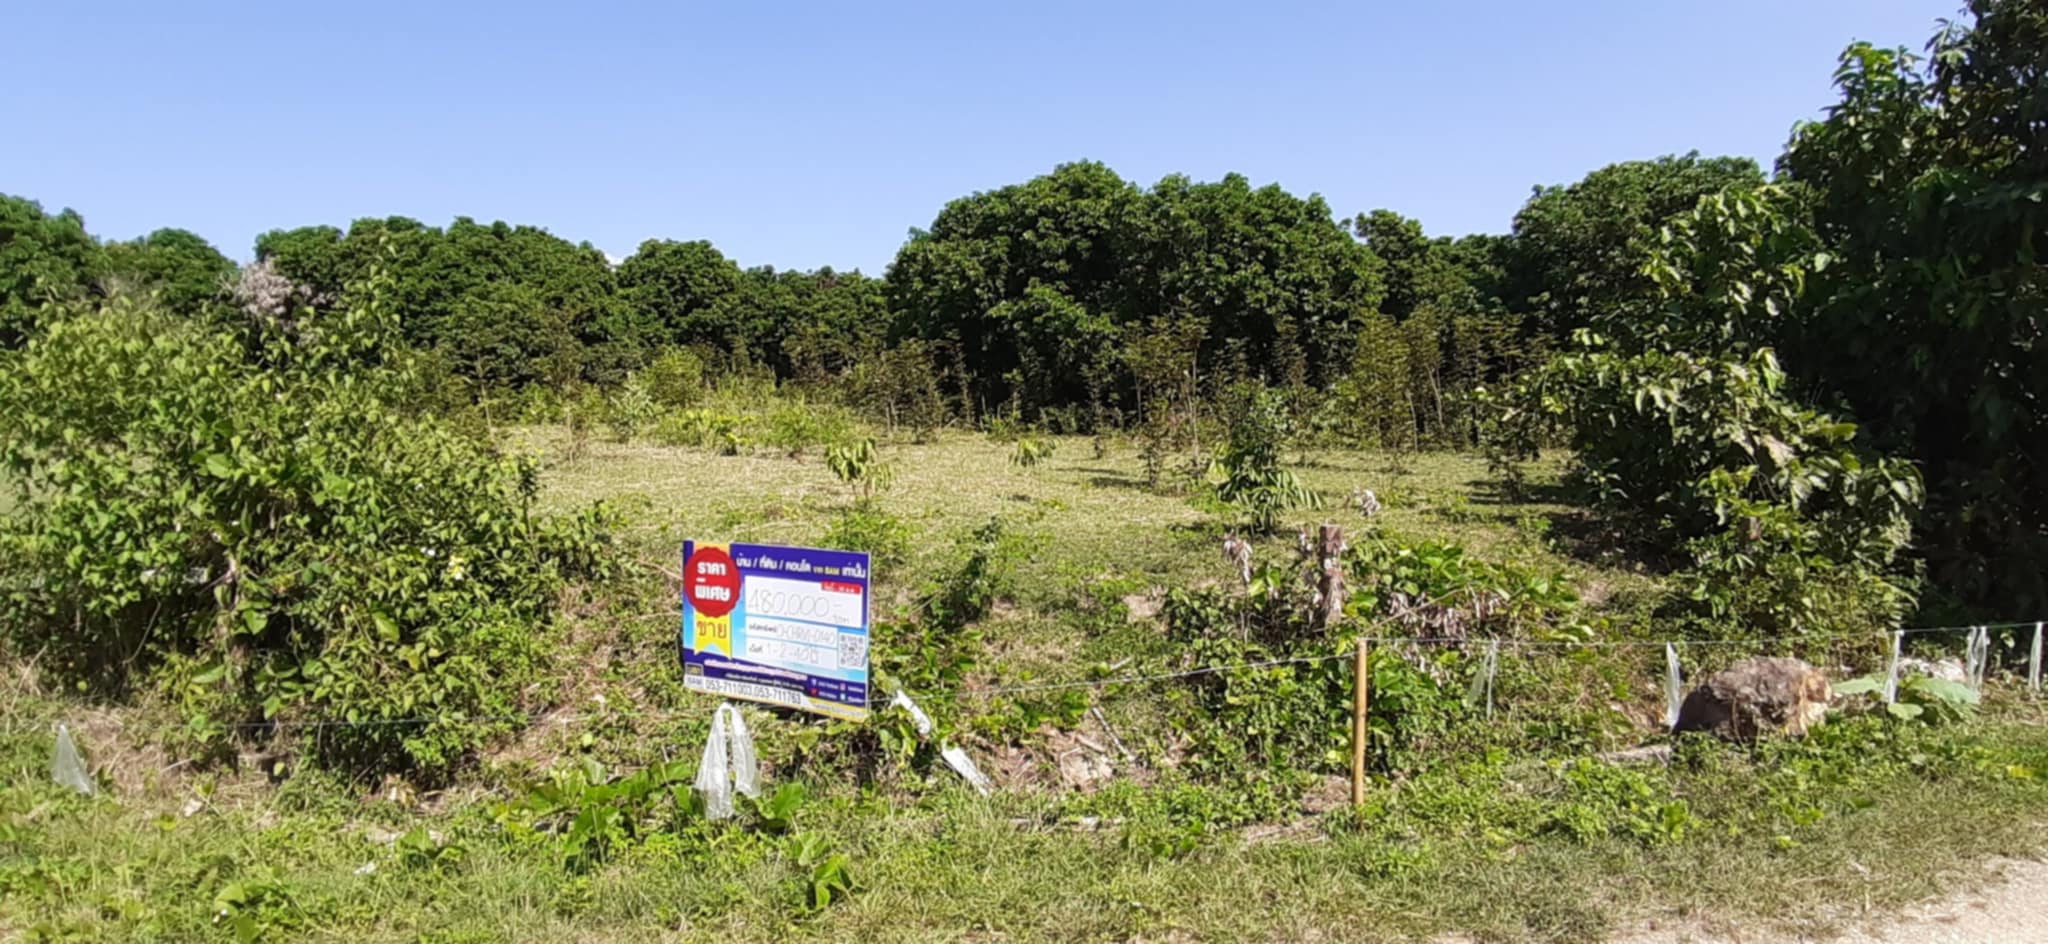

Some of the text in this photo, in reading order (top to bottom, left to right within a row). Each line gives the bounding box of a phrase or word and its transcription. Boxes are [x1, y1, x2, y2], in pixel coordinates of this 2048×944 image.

[697, 561, 726, 576] ราคา
[694, 577, 731, 601] พิเศษ
[696, 620, 727, 639] ขาย
